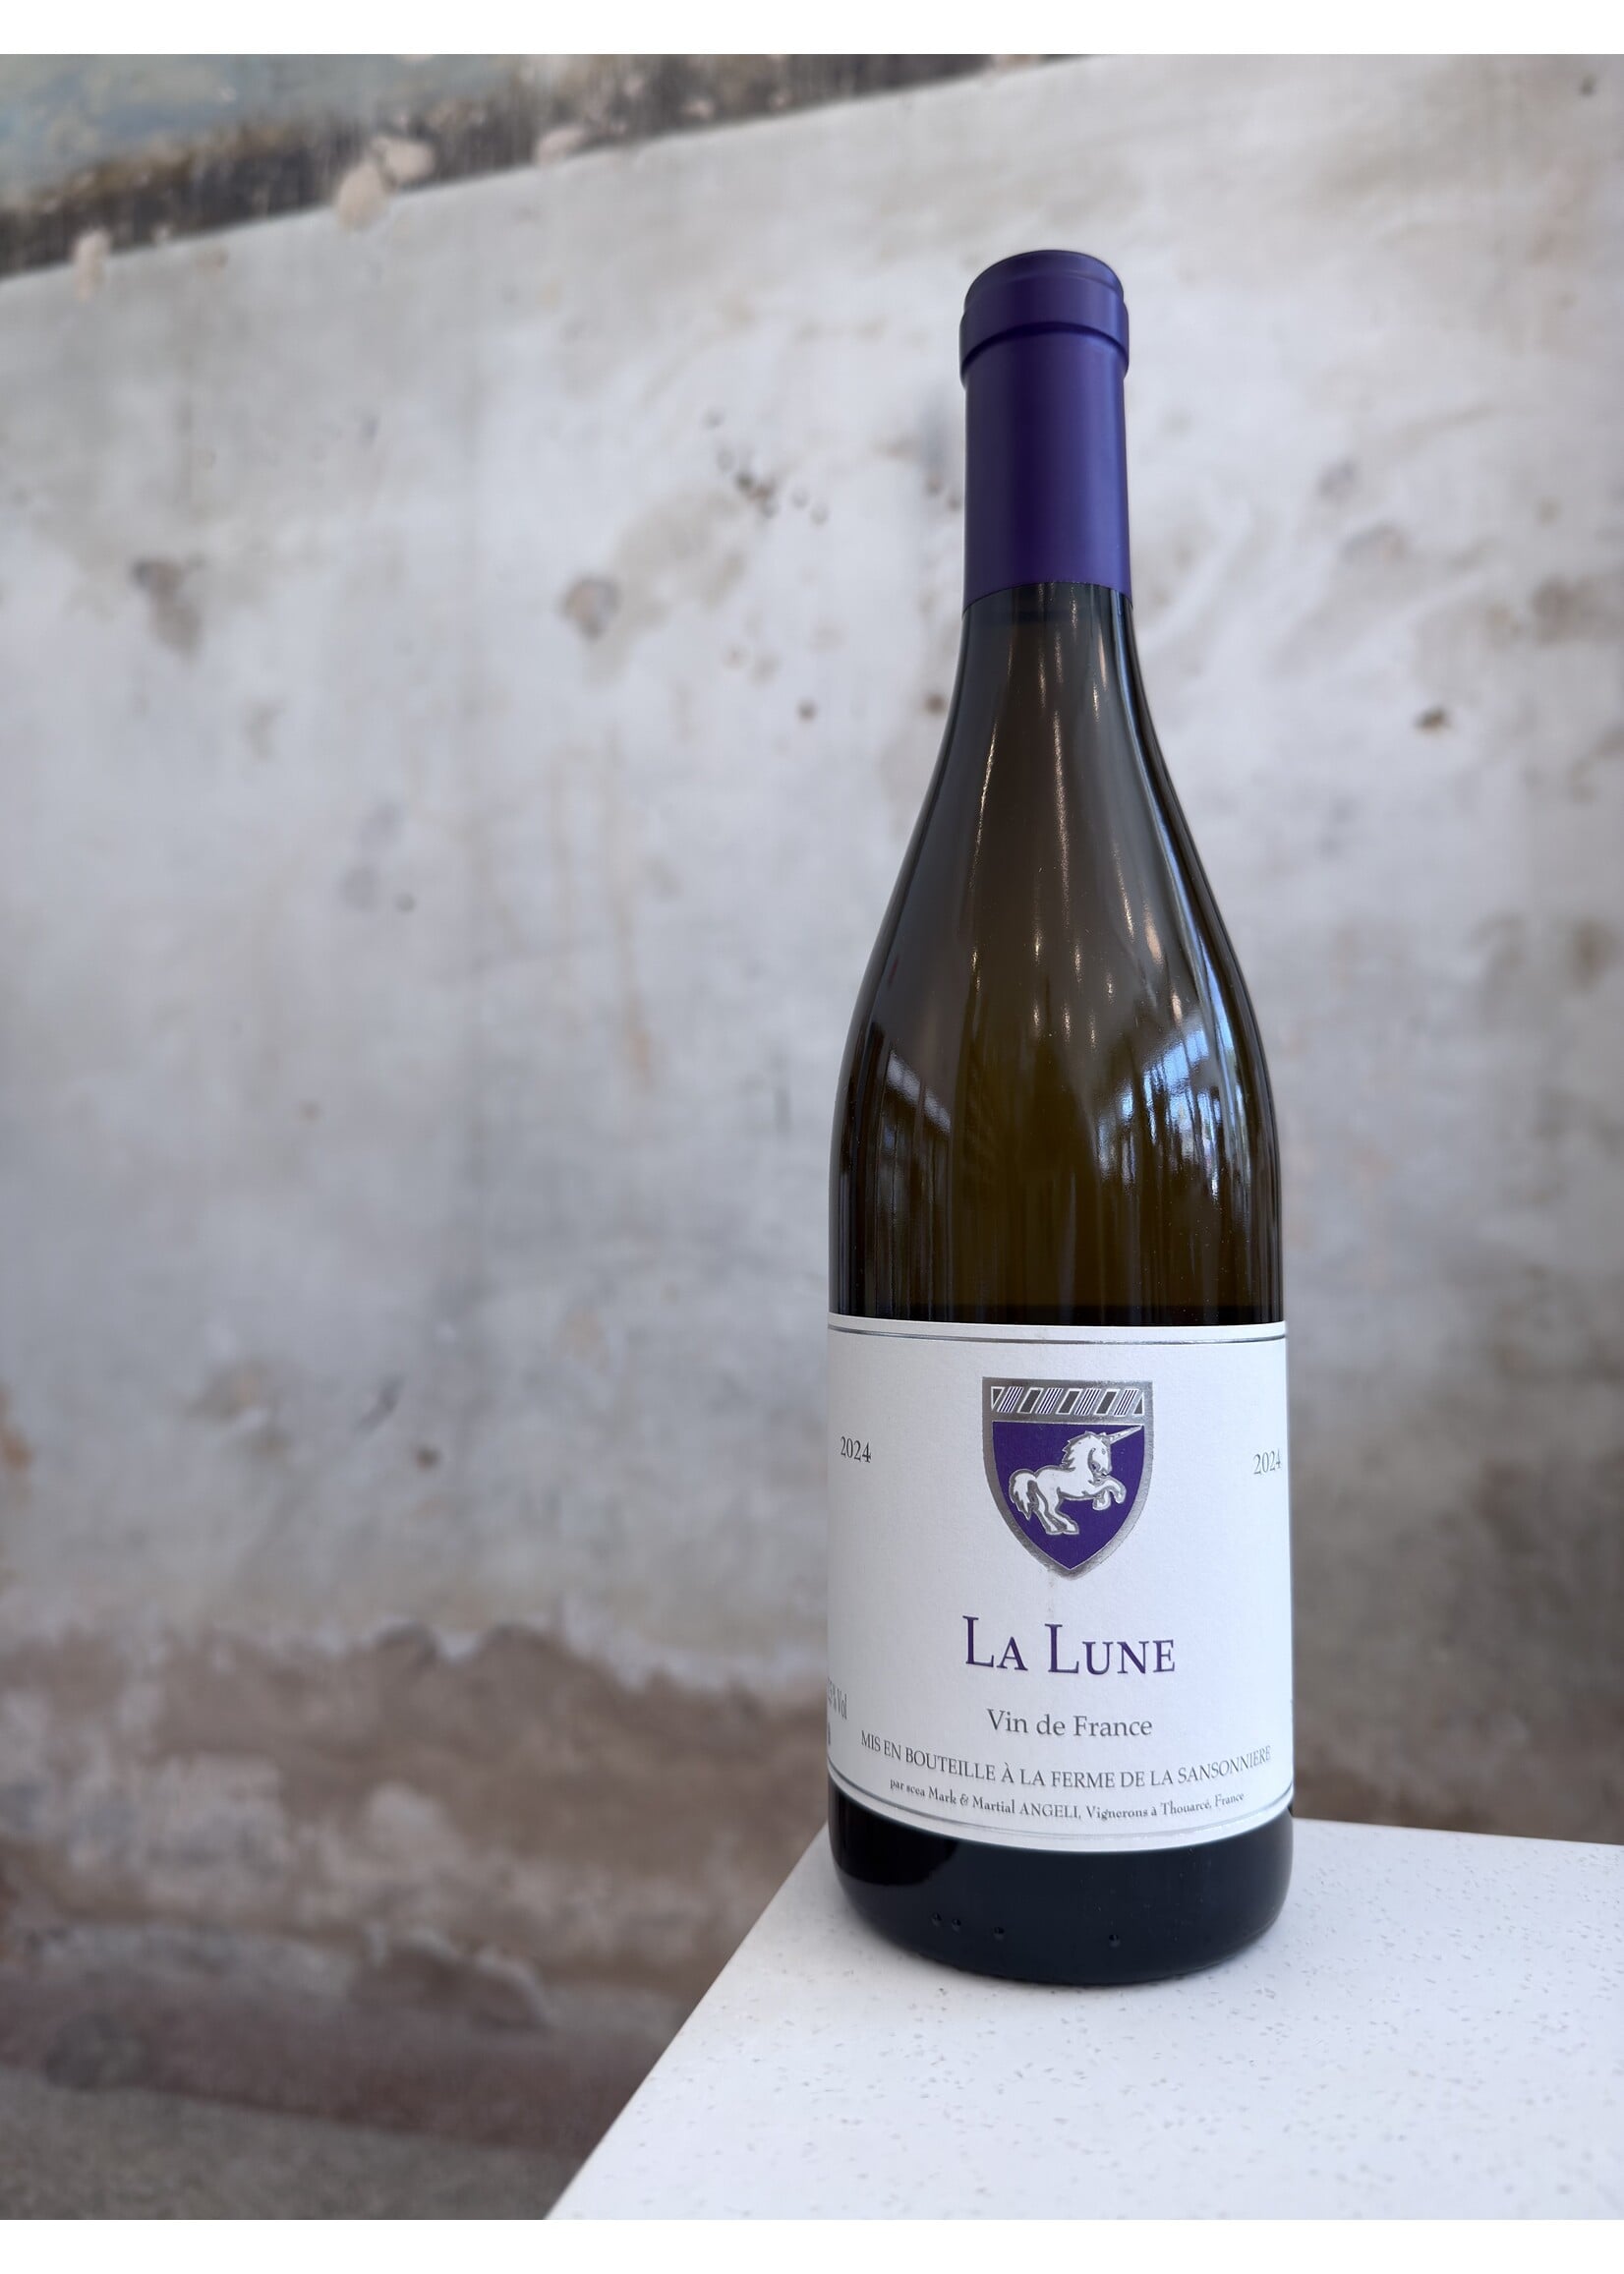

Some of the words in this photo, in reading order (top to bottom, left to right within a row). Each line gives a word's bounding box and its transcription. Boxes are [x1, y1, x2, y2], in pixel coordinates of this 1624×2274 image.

[841, 1436, 871, 1463] 2024
[1253, 1449, 1281, 1475] 2024
[962, 1615, 1028, 1671] LA
[1045, 1623, 1175, 1675] LUNE
[986, 1708, 1029, 1734] Vin
[1035, 1713, 1067, 1737] de
[1073, 1715, 1153, 1737] France
[861, 1729, 882, 1753] MIS
[883, 1739, 901, 1762] EN
[904, 1746, 996, 1782] BOUTEILLE
[1001, 1761, 1015, 1784] À
[1018, 1768, 1046, 1787] LA
[1050, 1771, 1116, 1789] FERME
[1120, 1771, 1146, 1788] DE
[1150, 1769, 1174, 1786] LA
[890, 1778, 905, 1791] par
[905, 1784, 926, 1798] scea
[928, 1785, 957, 1805] Mark
[958, 1792, 969, 1807] &
[972, 1794, 1015, 1815] Martial
[1018, 1802, 1081, 1821] ANGELI,
[1085, 1805, 1149, 1823] Vignerons
[1150, 1804, 1158, 1817] à
[1160, 1798, 1212, 1816] Thouarcé,
[1214, 1792, 1245, 1808] France
